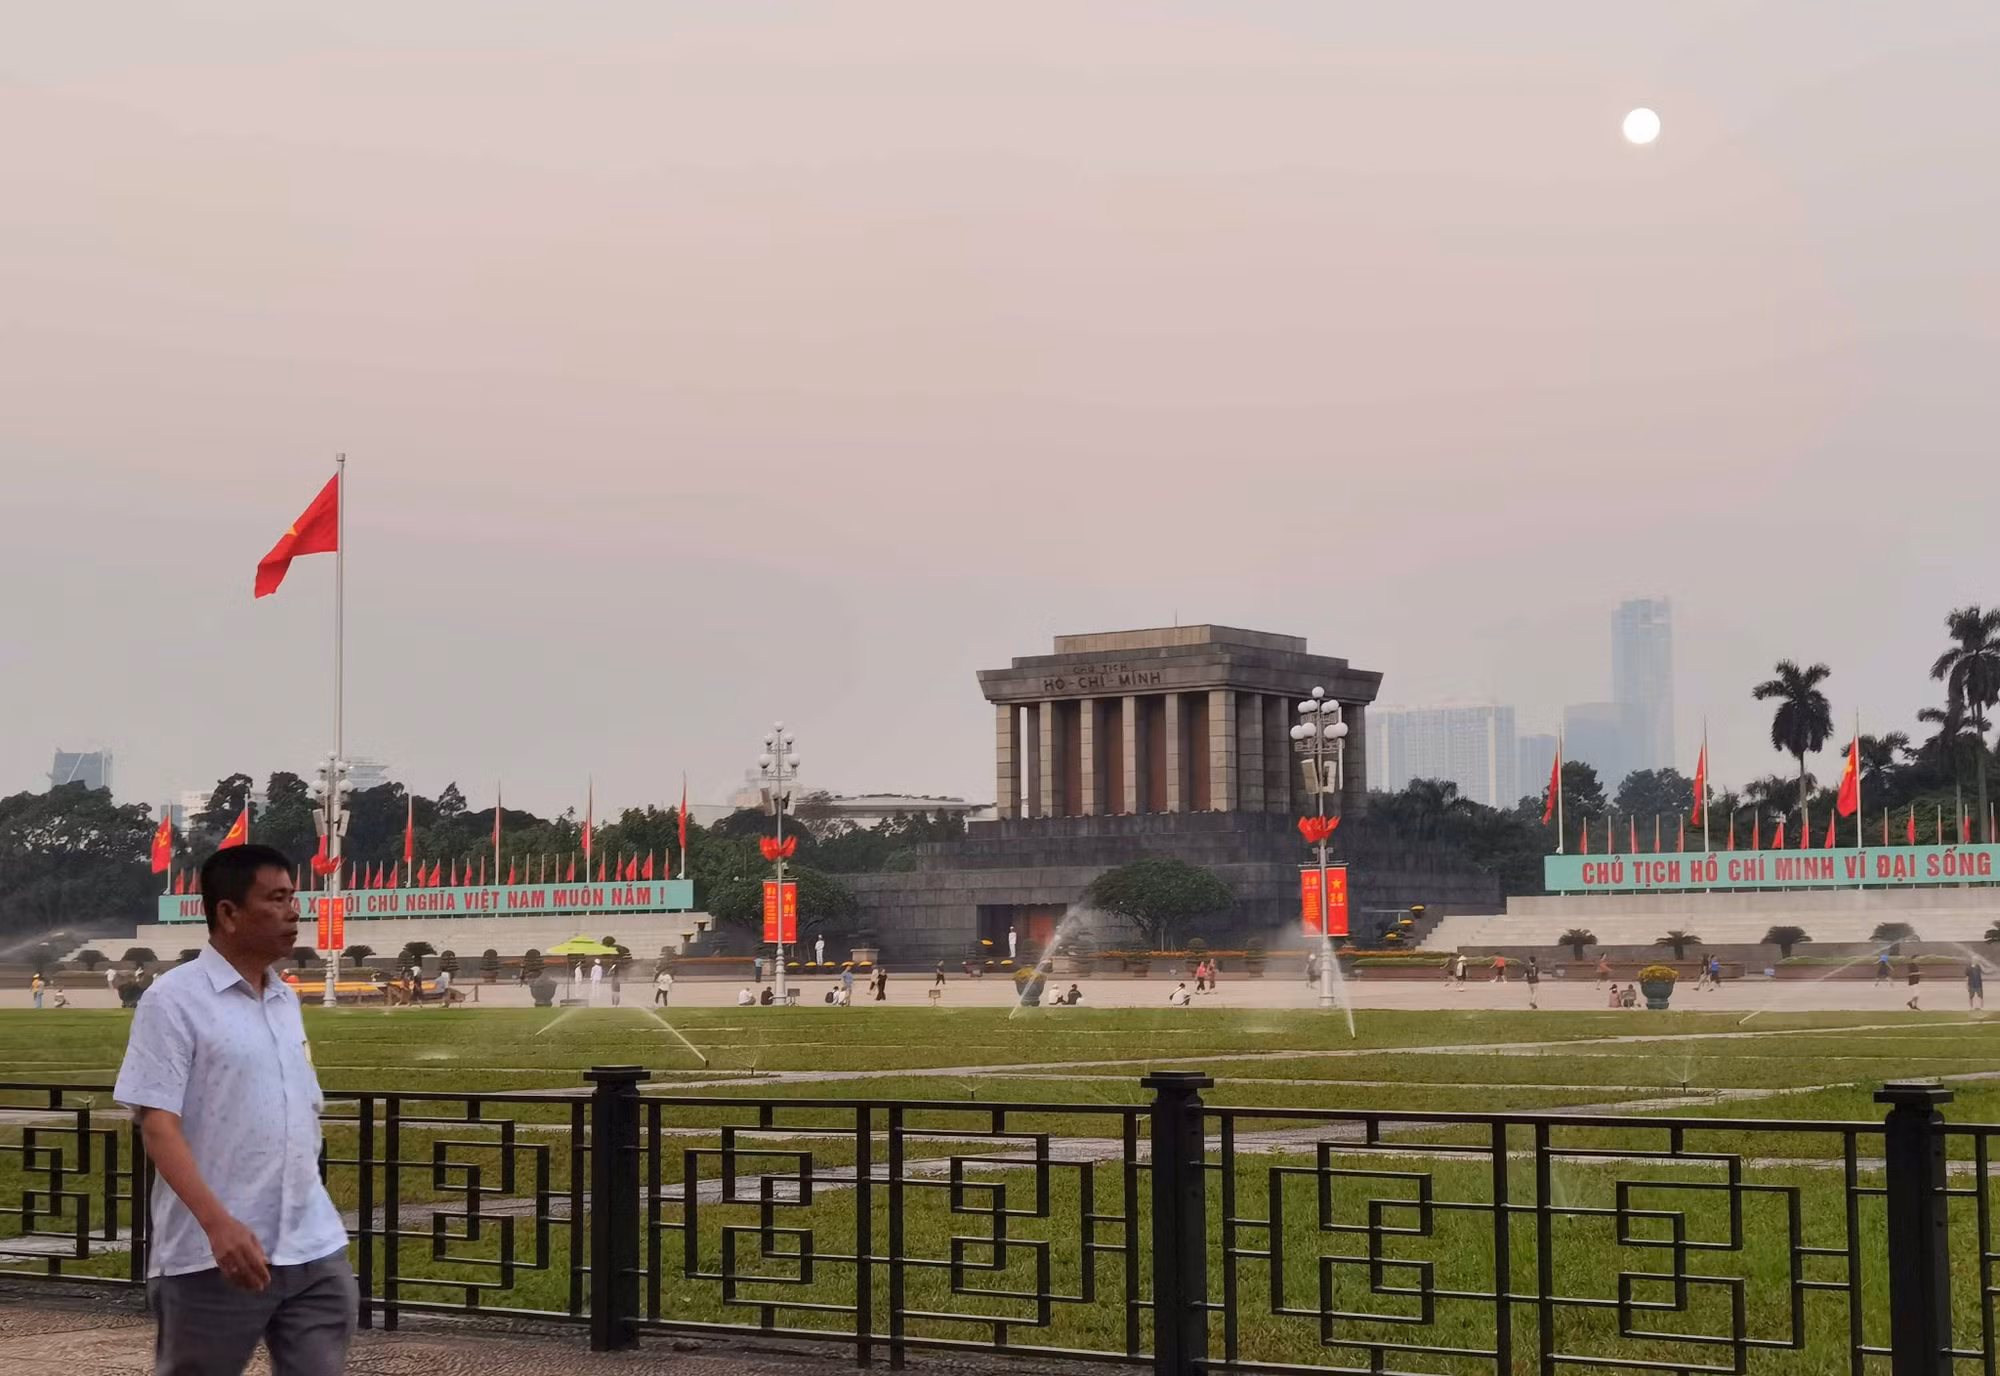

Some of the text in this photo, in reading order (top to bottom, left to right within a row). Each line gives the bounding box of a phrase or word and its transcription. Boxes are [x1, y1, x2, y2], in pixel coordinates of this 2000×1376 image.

[1582, 846, 1991, 887] CHỦ TỊCH HỒ CHÍ MINH VĨ ĐẠI SỐNG
[345, 892, 360, 916] ỘI
[367, 890, 399, 912] CHỦ
[406, 889, 455, 912] NGHĨA
[464, 888, 500, 913] VIỆT
[507, 890, 545, 909] NAM
[553, 885, 604, 907] MUÔN
[612, 883, 652, 906] NĂM
